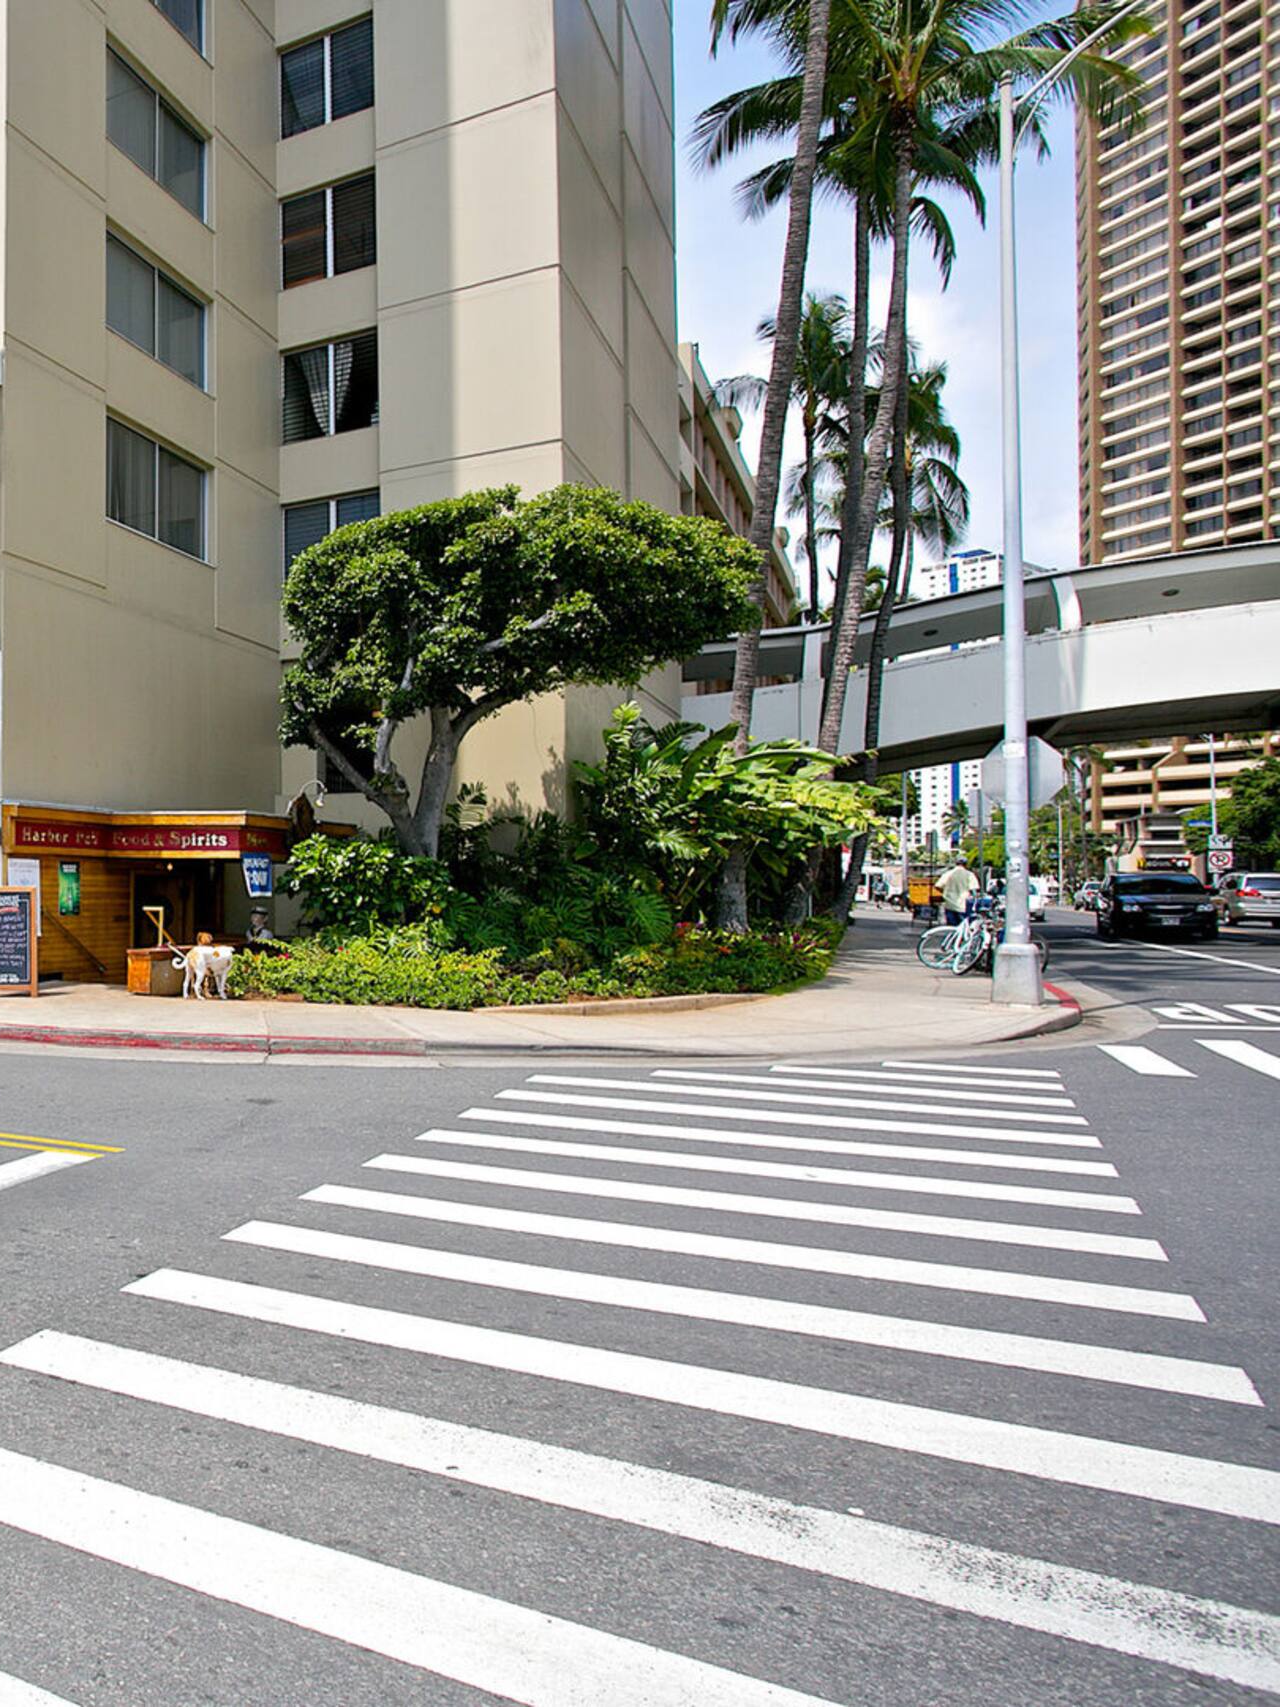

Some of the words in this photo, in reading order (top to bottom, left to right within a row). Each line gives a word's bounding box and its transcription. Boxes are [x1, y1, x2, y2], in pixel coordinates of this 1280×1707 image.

[22, 826, 69, 843] Harbor
[112, 831, 150, 846] Food
[170, 831, 228, 848] Spirits
